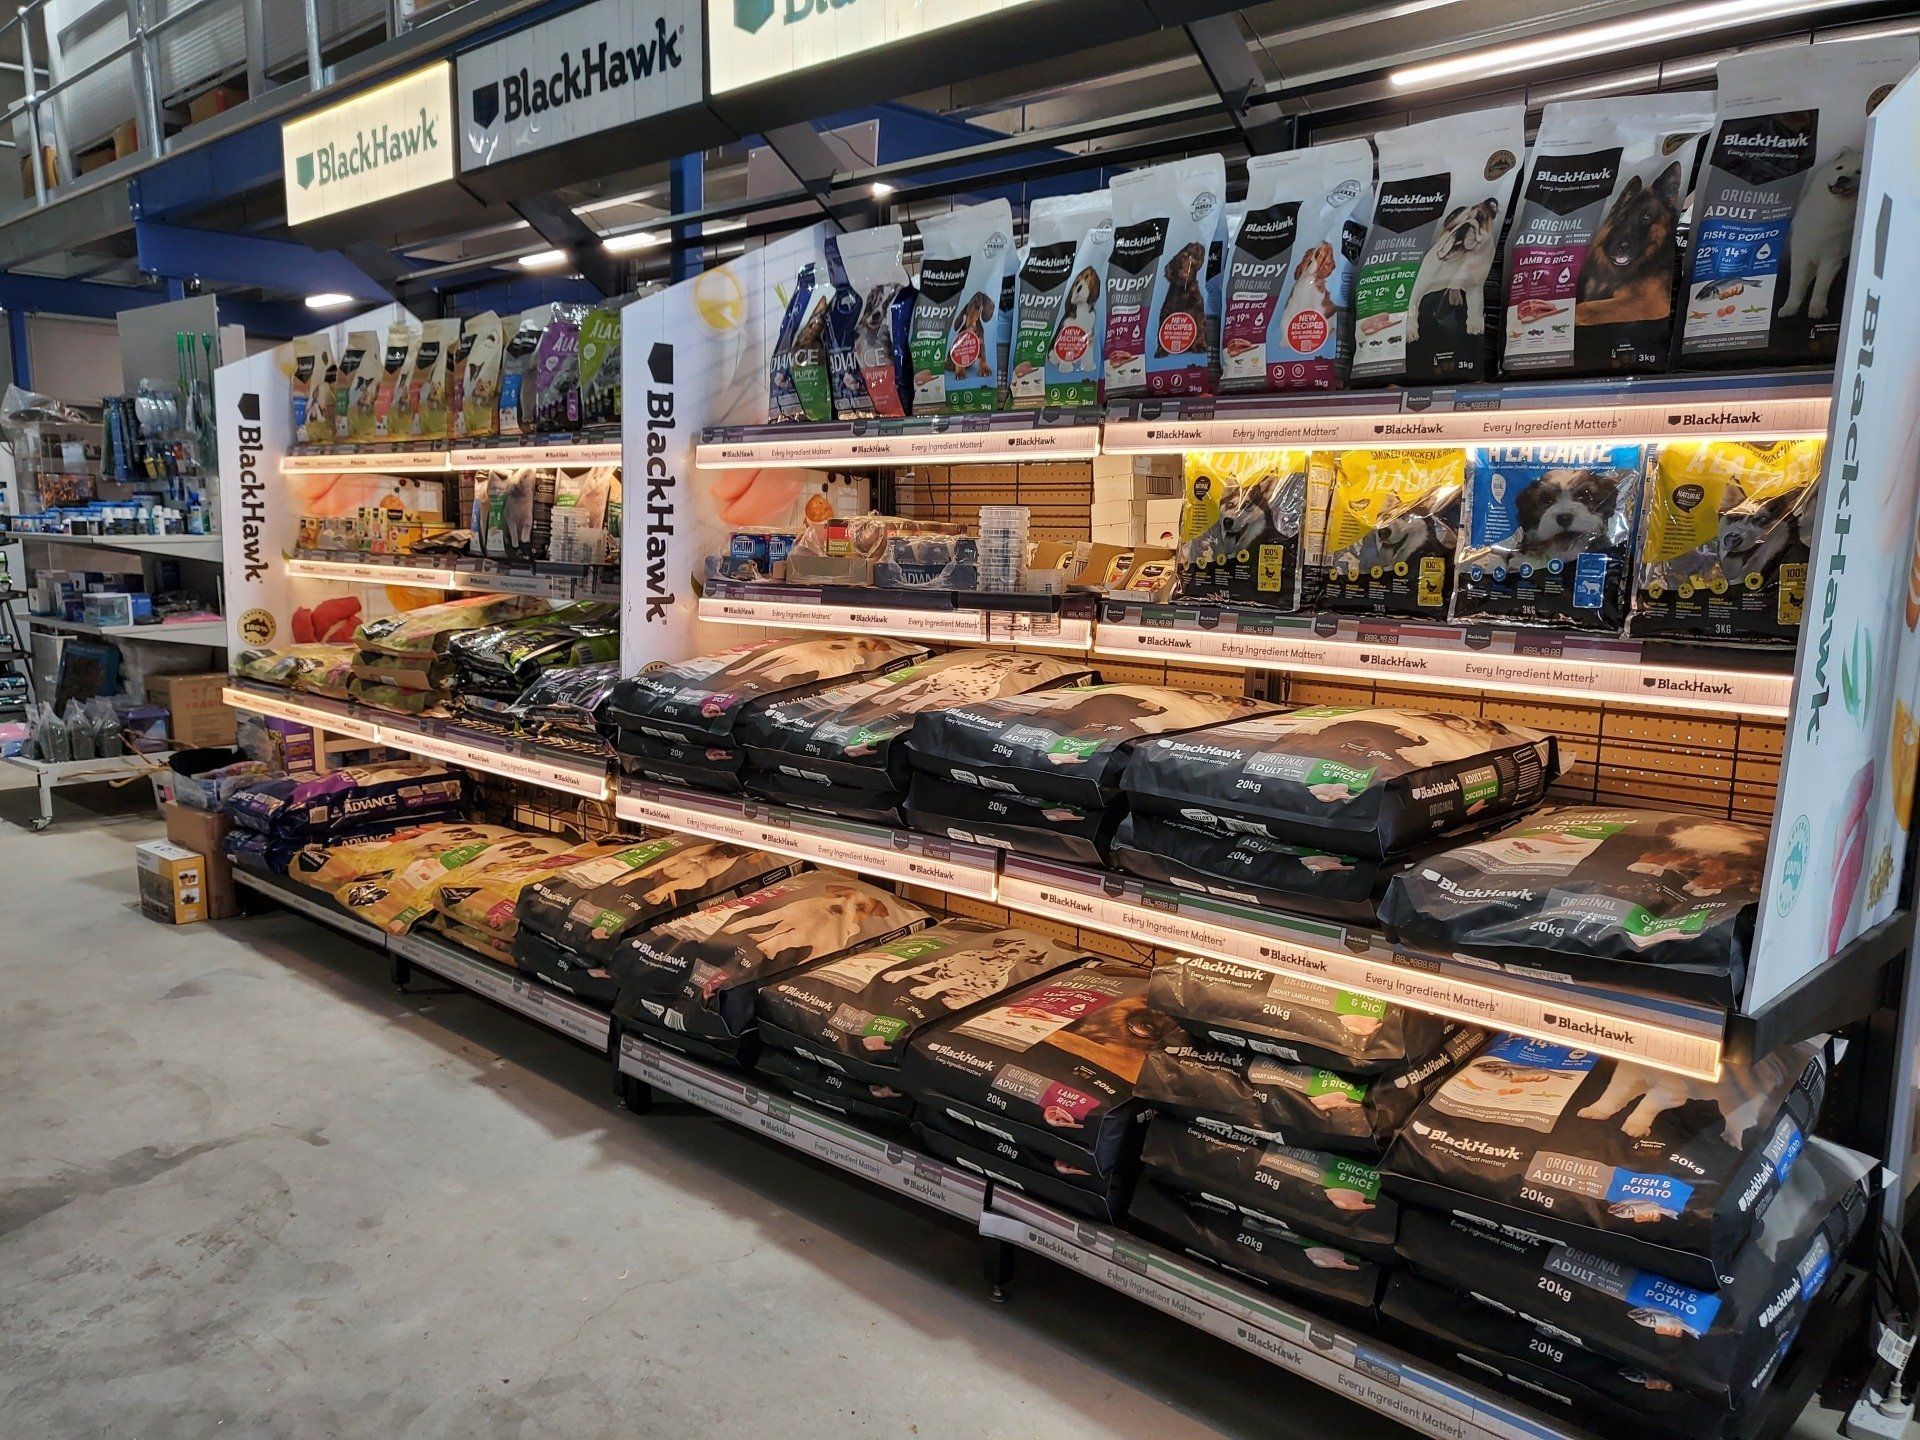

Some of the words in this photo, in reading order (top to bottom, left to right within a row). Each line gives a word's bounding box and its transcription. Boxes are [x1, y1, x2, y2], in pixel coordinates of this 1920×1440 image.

[317, 107, 438, 187] BlackHawk
[1722, 132, 1809, 149] BlackHawk
[1535, 167, 1611, 184] BlackHawk
[1380, 191, 1445, 207] BlackHawk
[1720, 188, 1782, 205] ORIGINAL
[1703, 205, 1757, 220] ADULT
[1244, 215, 1294, 232] BlackHawk
[1530, 218, 1583, 232] ORIGINAL
[1374, 236, 1417, 251] ORIGINAL
[1515, 233, 1562, 247] ADULT
[1703, 230, 1726, 241] FISH
[1727, 232, 1736, 241] &
[1737, 229, 1779, 242] POTATO
[1026, 254, 1073, 268] BlackHawk
[1363, 251, 1399, 267] ADULT
[1696, 246, 1719, 260] 22%
[1724, 246, 1748, 258] 14%
[922, 267, 967, 282] BlackHawk
[1231, 262, 1288, 278] PUPPY
[1107, 273, 1154, 292] PUPPY
[1019, 292, 1062, 309] PUPPY
[915, 304, 956, 319] PUPPY
[1298, 314, 1318, 323] NEW
[1291, 320, 1325, 331] RECIPES
[1457, 360, 1474, 370] 3kg
[1638, 353, 1656, 364] 3kg
[1188, 384, 1202, 394] 3kg
[1314, 378, 1328, 388] 3kg
[1482, 422, 1512, 435] Every
[1513, 419, 1571, 433] Ingredient
[1573, 418, 1618, 430] Matters
[1682, 411, 1762, 426] BlackHawk
[1155, 429, 1202, 440] BlackHawk
[1232, 428, 1256, 441] Every
[1256, 427, 1300, 440] Ingredient
[1301, 427, 1338, 438] Matters
[1384, 423, 1444, 436] BlackHawk
[1015, 435, 1056, 447] BlackHawk
[1676, 490, 1701, 500] NATURAL
[732, 540, 753, 554] CHUM
[1424, 561, 1442, 570] 100%
[1521, 604, 1537, 615] 3KG
[855, 614, 888, 625] BlackHawk
[1714, 623, 1733, 635] 3KG
[1146, 636, 1192, 649] BlackHawk
[1221, 642, 1244, 656] Every
[1245, 644, 1289, 658] Ingredient
[1290, 648, 1323, 660] Matters
[1370, 653, 1427, 669] BlackHawk
[1464, 663, 1494, 678] Every
[1495, 665, 1551, 683] Ingredient
[1552, 671, 1595, 685] Matters
[1657, 677, 1734, 696] BlackHawk
[944, 707, 1006, 730] BlackHawk
[1004, 733, 1033, 745] ADULT
[804, 742, 821, 755] 20kg
[991, 743, 1014, 758] 20kg
[1169, 739, 1245, 761] BlackHawk
[1247, 762, 1284, 776] ADULT
[1260, 753, 1306, 769] ORIGINAL
[1321, 762, 1370, 780] CHICKEN
[1322, 769, 1331, 778] &
[1333, 771, 1359, 784] RICE
[1464, 773, 1483, 786] ADULT
[1235, 779, 1262, 794] 20kg
[1419, 777, 1460, 801] BlackHawk
[345, 793, 397, 814] ADVANCE
[987, 800, 1008, 815] 20kg
[766, 833, 799, 849] BlackHawk
[915, 863, 955, 881] BlackHawk
[1437, 876, 1534, 902] BlackHawk
[1048, 893, 1093, 914] BlackHawk
[1560, 895, 1616, 911] ORIGINAL
[1122, 913, 1145, 929] Every
[1145, 917, 1190, 938] Ingredient
[1189, 929, 1224, 947] Matters
[1528, 920, 1565, 938] 20kg
[1269, 949, 1329, 972] BlackHawk
[1187, 957, 1266, 982] BlackHawk
[1190, 972, 1207, 982] Every
[1206, 974, 1232, 987] ingredient
[1231, 977, 1255, 989] matters
[785, 984, 836, 1013] BlackHawk
[1365, 972, 1394, 991] Every
[1395, 976, 1451, 1001] Ingredient
[1452, 994, 1497, 1012] Matters
[907, 1004, 925, 1019] 20kg
[1262, 1003, 1291, 1021] 20kg
[873, 1017, 902, 1029] CHICKEN
[1557, 1016, 1635, 1045] BlackHawk
[821, 1027, 840, 1043] 20kg
[936, 1043, 996, 1073] BlackHawk
[1007, 1068, 1042, 1087] ORIGINAL
[1408, 1052, 1451, 1086] BlackHawk
[995, 1077, 1024, 1094] ADULT
[1093, 1078, 1116, 1096] 20kg
[986, 1092, 1008, 1110] 20kg
[1056, 1097, 1076, 1109] RICE
[996, 1141, 1019, 1160] 20kg
[1428, 1127, 1523, 1161] BlackHawk
[1430, 1143, 1451, 1155] Every
[1449, 1146, 1483, 1164] ingredient
[1481, 1155, 1508, 1169] matters
[1668, 1152, 1706, 1175] 20kg
[1545, 1156, 1599, 1178] ORIGINAL
[1253, 1170, 1281, 1190] 20kg
[1338, 1172, 1347, 1182] &
[1347, 1174, 1373, 1191] RICE
[1532, 1168, 1576, 1187] ADULT
[1630, 1176, 1658, 1188] FISH
[1659, 1178, 1672, 1189] &
[909, 1179, 947, 1202] BlackHawk
[1519, 1187, 1556, 1209] 20kg
[1621, 1184, 1673, 1199] POTATO
[1236, 1233, 1264, 1252] 20kg
[1449, 1220, 1472, 1234] Every
[1470, 1224, 1500, 1245] ingredient
[1498, 1235, 1528, 1254] matters
[1036, 1234, 1081, 1264] BlackHawk
[1551, 1256, 1594, 1283] ADULT
[1106, 1268, 1130, 1289] Every
[1128, 1277, 1171, 1305] Ingredient
[1170, 1296, 1204, 1319] Matters
[1536, 1276, 1573, 1302] 20kg
[1653, 1279, 1686, 1297] FISH
[1687, 1290, 1698, 1303] &
[1645, 1289, 1698, 1316] POTATO
[1246, 1331, 1303, 1366] BlackHawk
[1528, 1338, 1564, 1362] 20kg
[1337, 1372, 1365, 1397] Every
[1365, 1383, 1421, 1419] Ingredient
[1421, 1406, 1465, 1439] Matters
